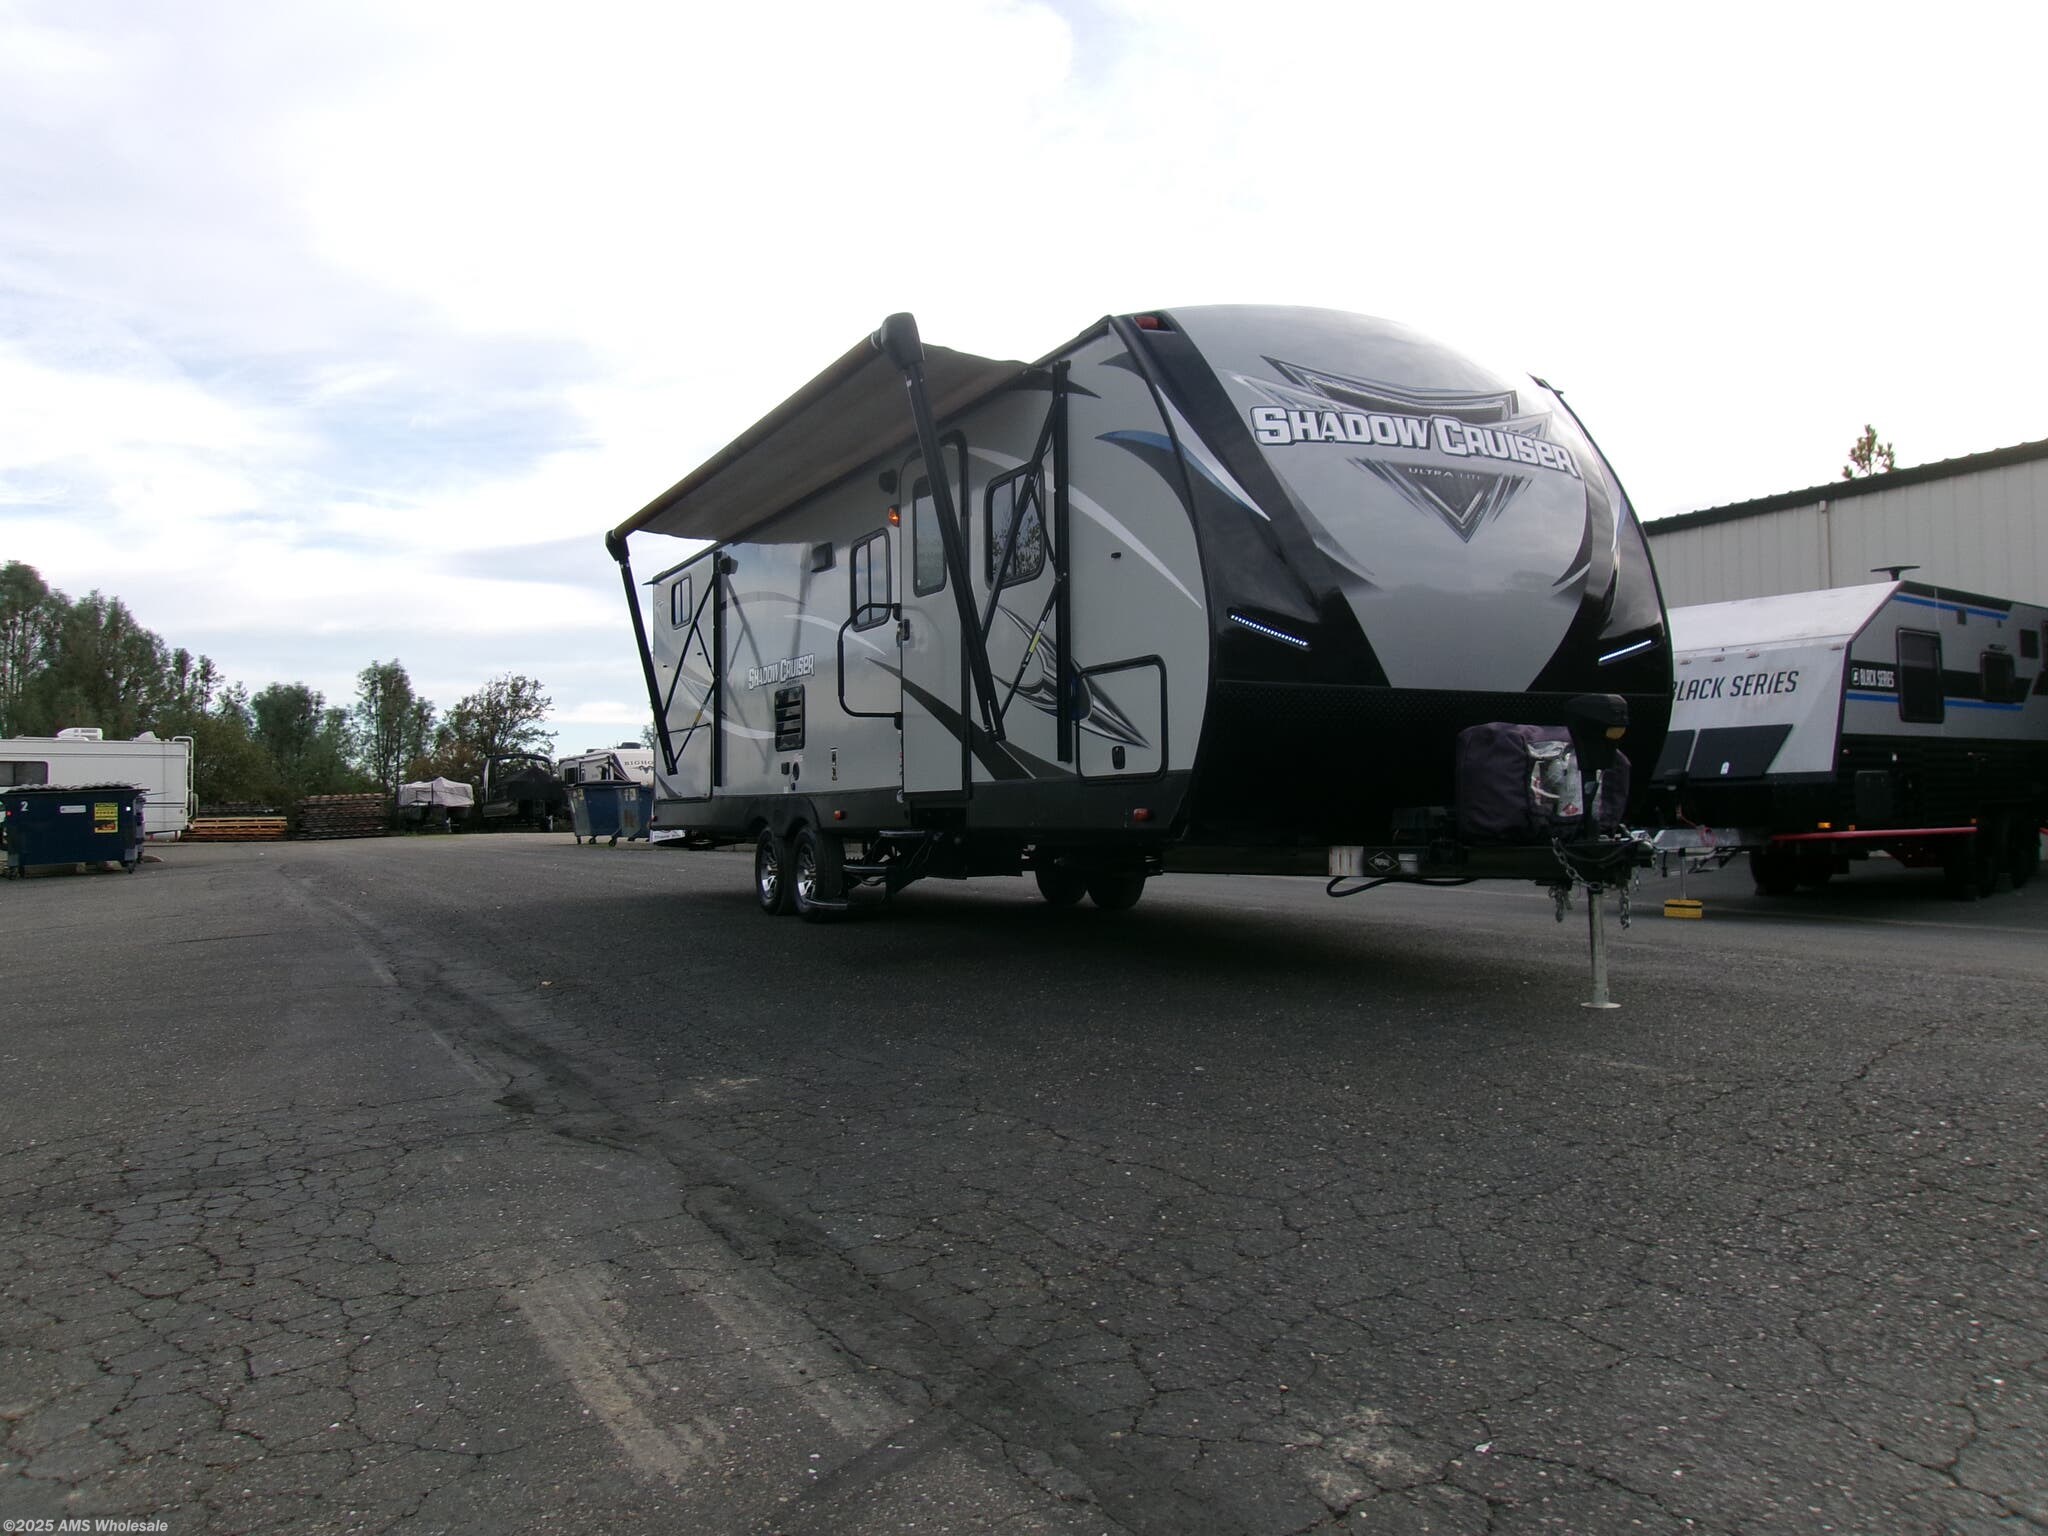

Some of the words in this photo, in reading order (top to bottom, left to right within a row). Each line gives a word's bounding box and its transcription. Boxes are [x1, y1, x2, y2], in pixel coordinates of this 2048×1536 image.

[1251, 407, 1430, 449] SHADOW
[1430, 415, 1583, 479] CRUISER
[749, 664, 779, 690] SHADOW
[780, 653, 815, 682] CRUISER
[1730, 670, 1799, 697] SERIES
[20, 801, 29, 812] 2
